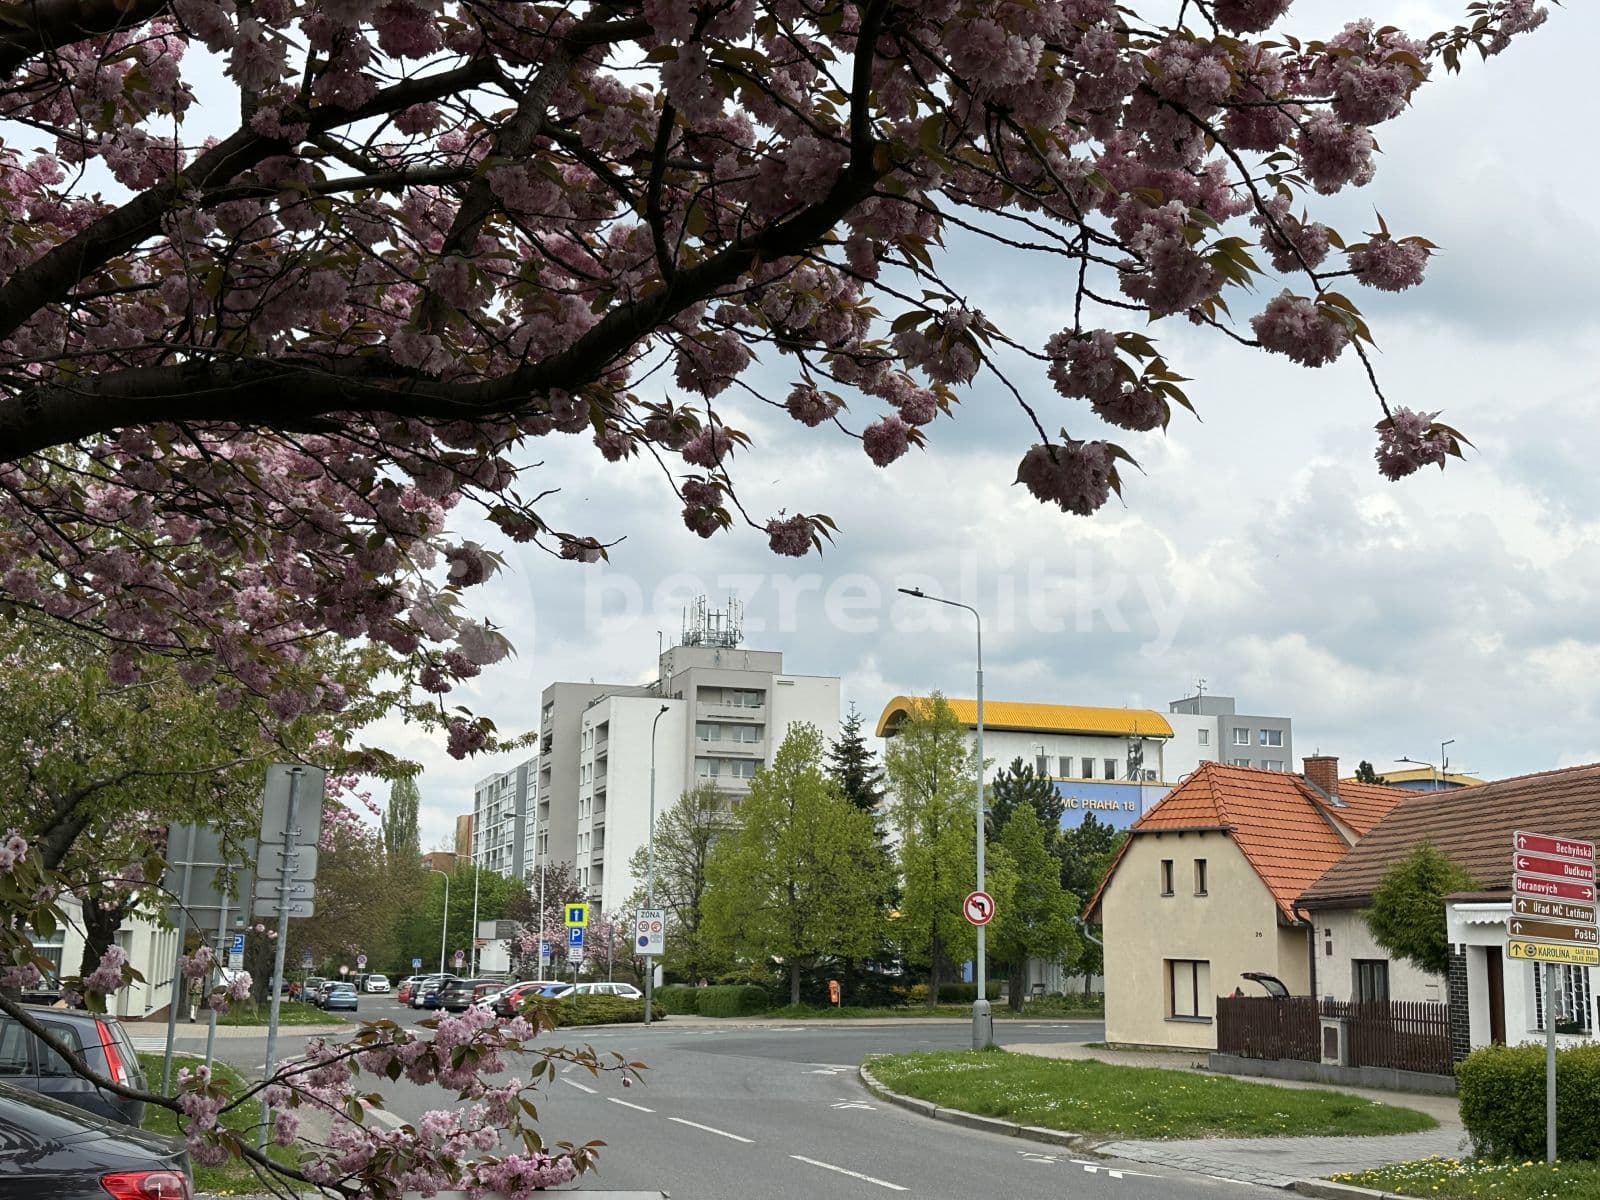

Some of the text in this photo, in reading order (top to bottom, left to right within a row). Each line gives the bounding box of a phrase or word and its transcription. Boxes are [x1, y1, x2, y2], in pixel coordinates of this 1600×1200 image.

[1082, 800, 1120, 810] PRAHA
[1123, 801, 1135, 811] 18
[1556, 842, 1592, 857] Bechyňská
[1564, 864, 1592, 878] Dudkova
[1517, 879, 1558, 894] Beranových
[1533, 902, 1593, 921] Úřad MČ Letňany
[571, 928, 581, 941] P
[1574, 928, 1596, 940] Pošta
